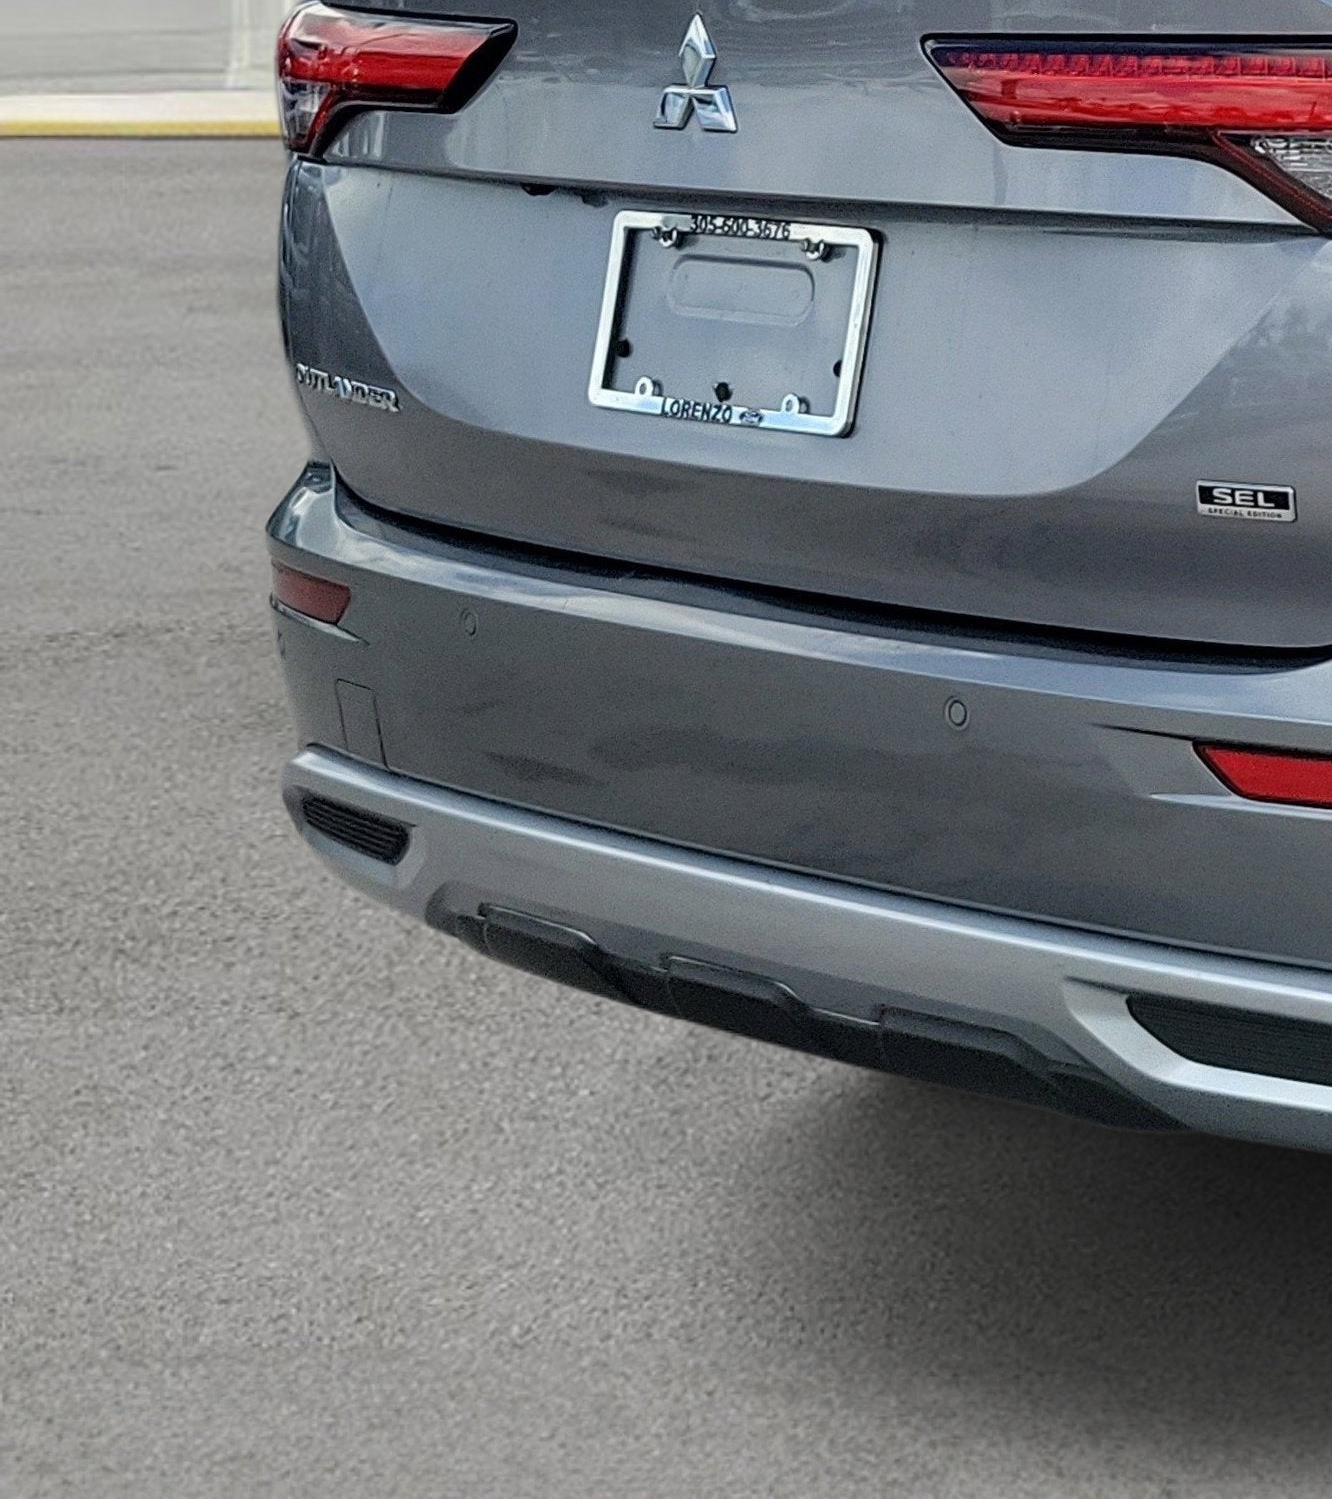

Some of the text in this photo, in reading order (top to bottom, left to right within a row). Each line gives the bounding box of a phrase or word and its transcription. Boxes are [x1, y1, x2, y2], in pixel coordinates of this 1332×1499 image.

[661, 396, 733, 424] LORENZO
[1211, 487, 1276, 508] SEL
[1207, 507, 1283, 520] SPECIAL EDITION
